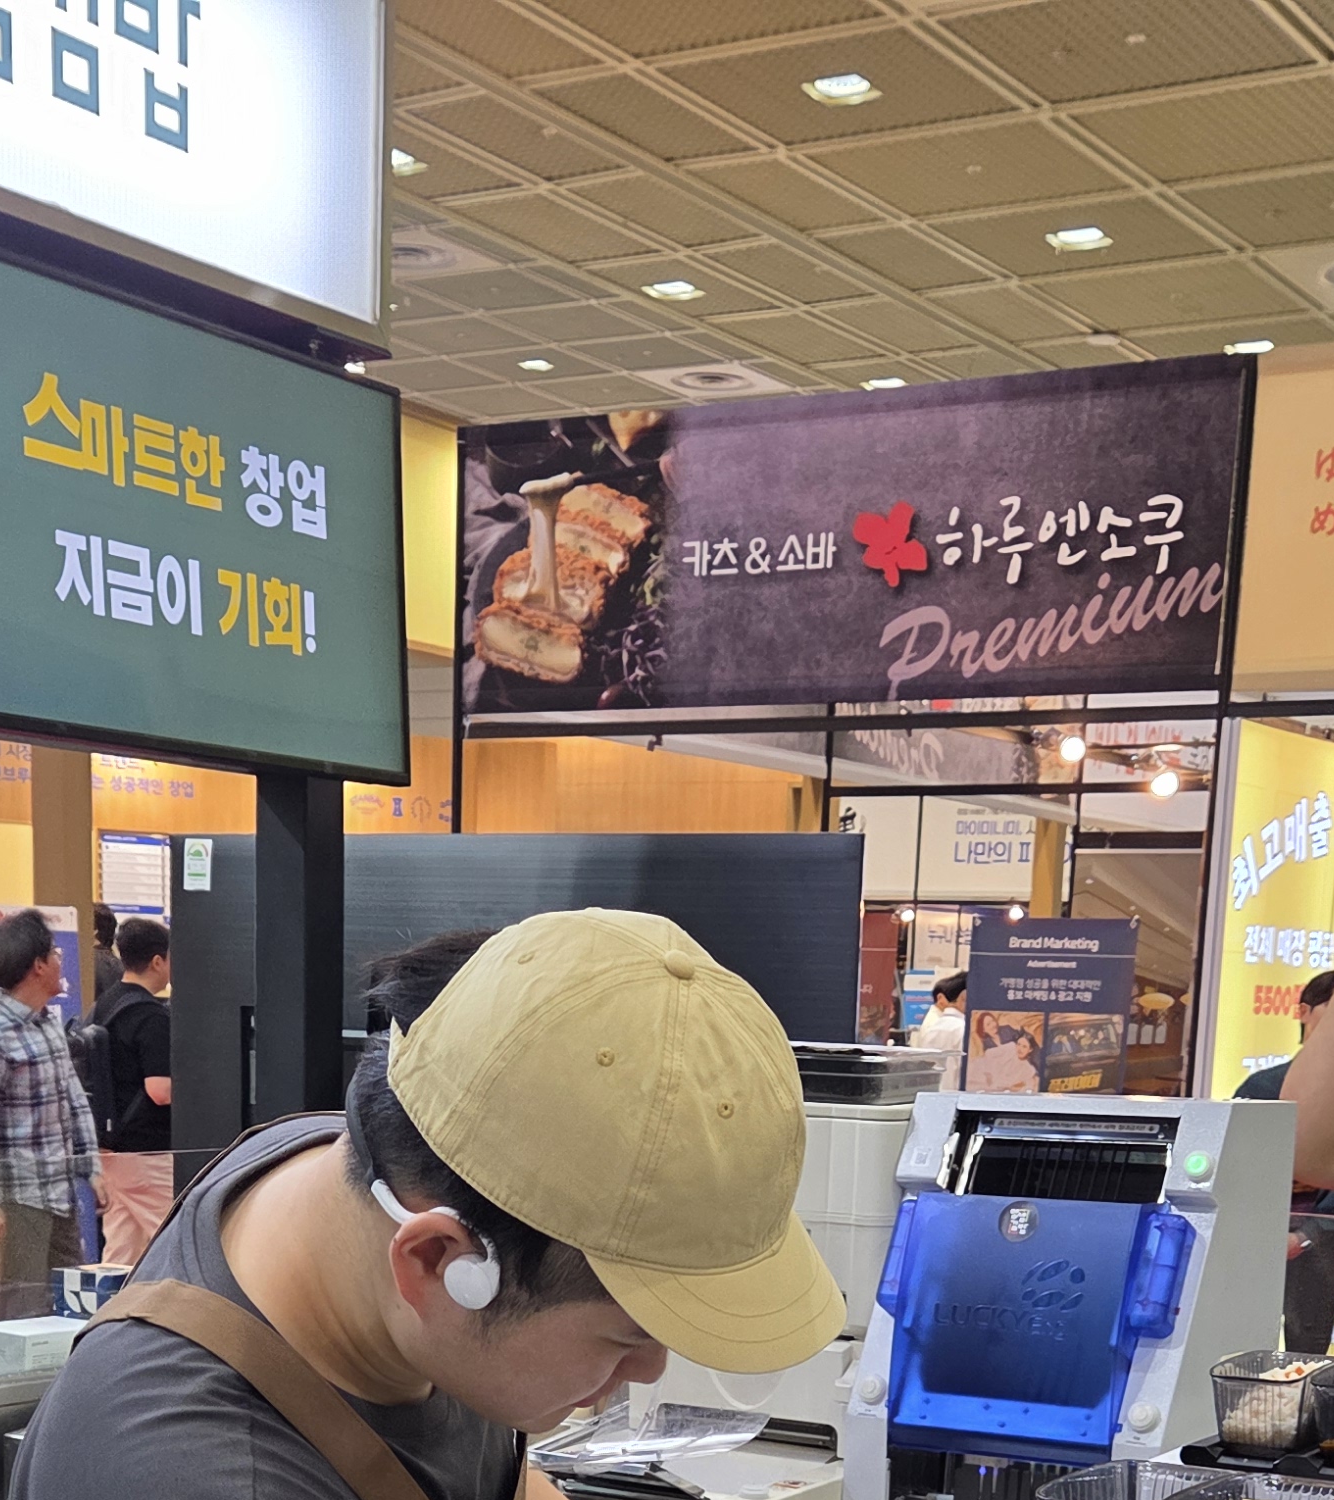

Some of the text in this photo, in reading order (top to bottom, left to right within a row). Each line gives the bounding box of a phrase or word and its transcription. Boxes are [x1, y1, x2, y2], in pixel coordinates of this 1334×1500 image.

[23, 372, 330, 540] 스마트한 창업
[681, 492, 1187, 585] 카츠 & 소바 하루엔소쿠
[55, 529, 318, 658] 지금이 기회!
[879, 561, 1226, 700] Premium
[110, 774, 164, 796] 성공적인
[169, 781, 194, 798] 창업
[954, 841, 1012, 864] 나만의
[1232, 791, 1332, 910] 최고매출
[1009, 936, 1099, 952] Brand Marketing
[1244, 925, 1275, 964] 전체
[1277, 929, 1306, 967] 매장
